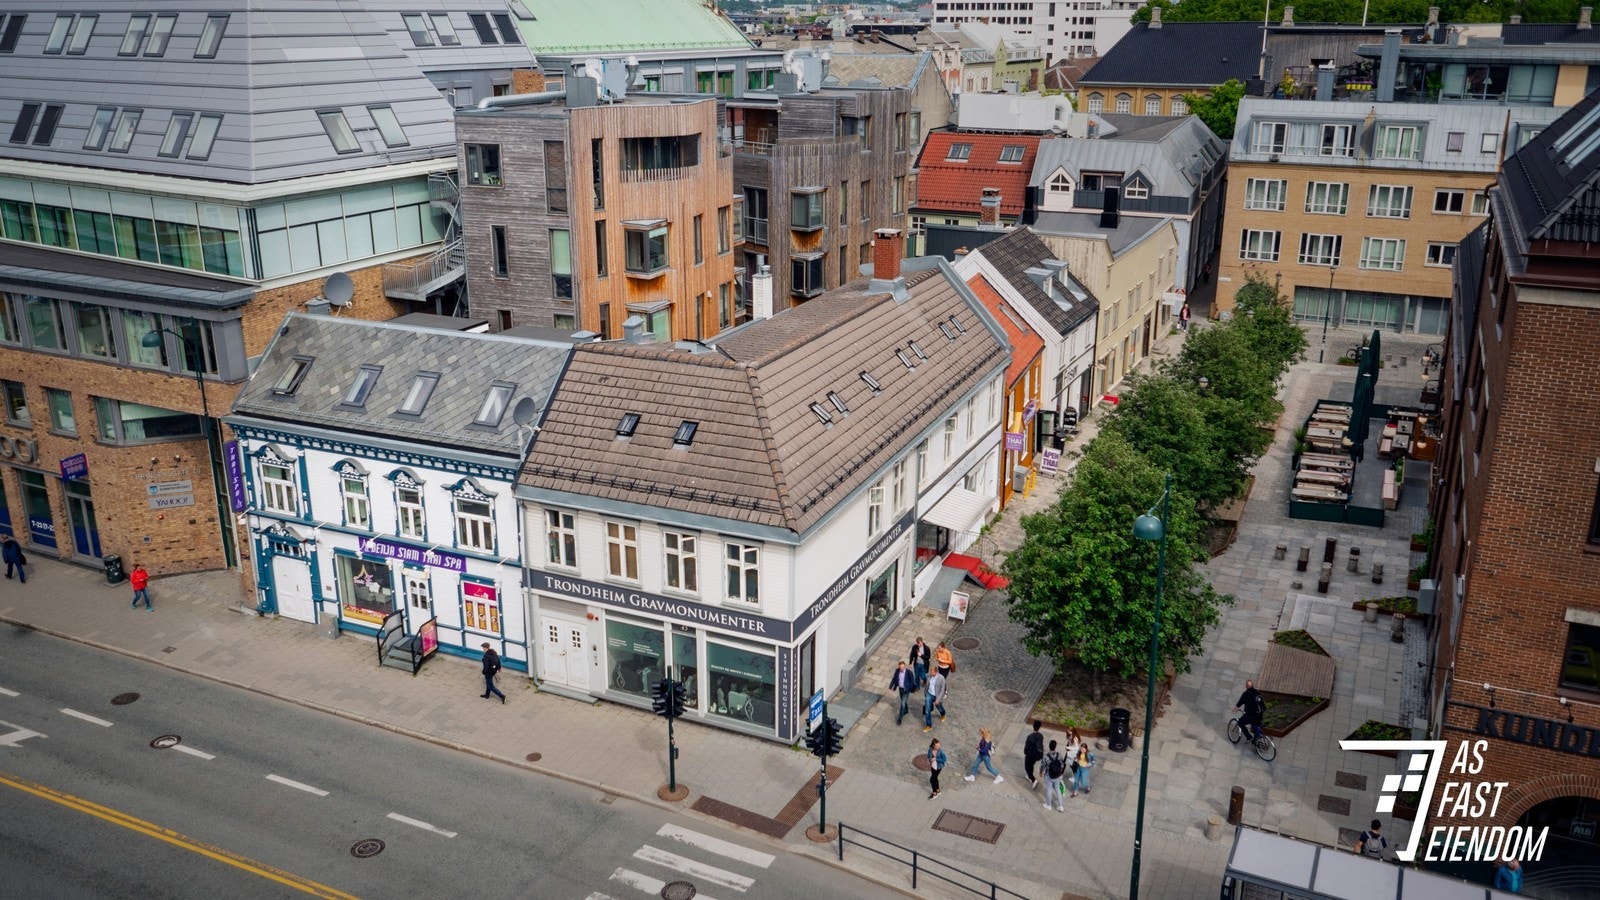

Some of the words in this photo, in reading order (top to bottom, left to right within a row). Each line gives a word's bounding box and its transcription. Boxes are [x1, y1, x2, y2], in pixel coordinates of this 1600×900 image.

[1007, 437, 1022, 445] THAI
[156, 496, 188, 507] YAHOO!
[397, 547, 420, 561] SIAM
[444, 556, 462, 570] SPA
[810, 575, 850, 619] TRONDHEIM
[850, 524, 902, 580] GRAVMONUMENTER
[544, 575, 626, 604] TRONDHEIM
[629, 593, 767, 633] GRAVMONUMENTER
